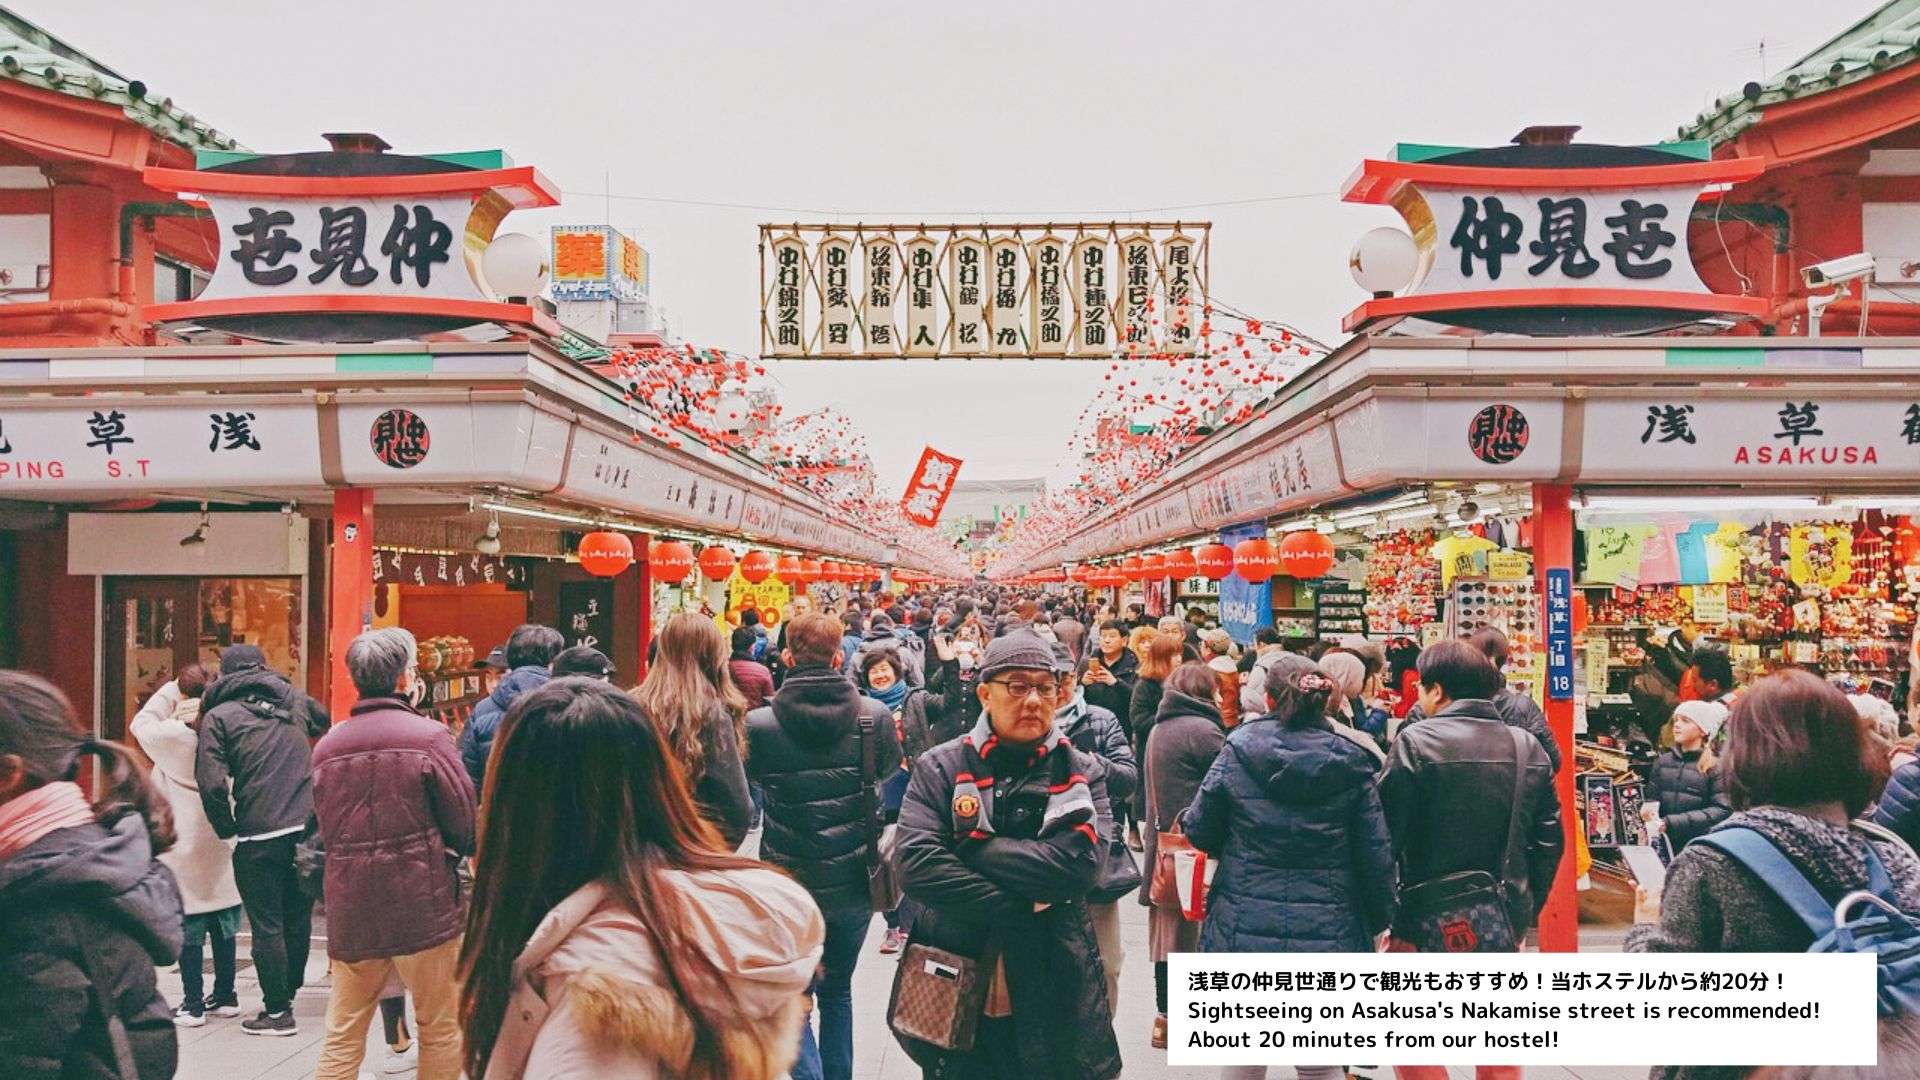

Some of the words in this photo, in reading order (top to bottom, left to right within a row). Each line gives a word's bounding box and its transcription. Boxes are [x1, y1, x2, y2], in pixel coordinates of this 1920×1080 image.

[1450, 196, 1676, 280] 仲見世
[1735, 446, 1879, 465] ASAKUSA
[1553, 597, 1570, 668] 浅草一丁目
[1553, 675, 1570, 691] 18
